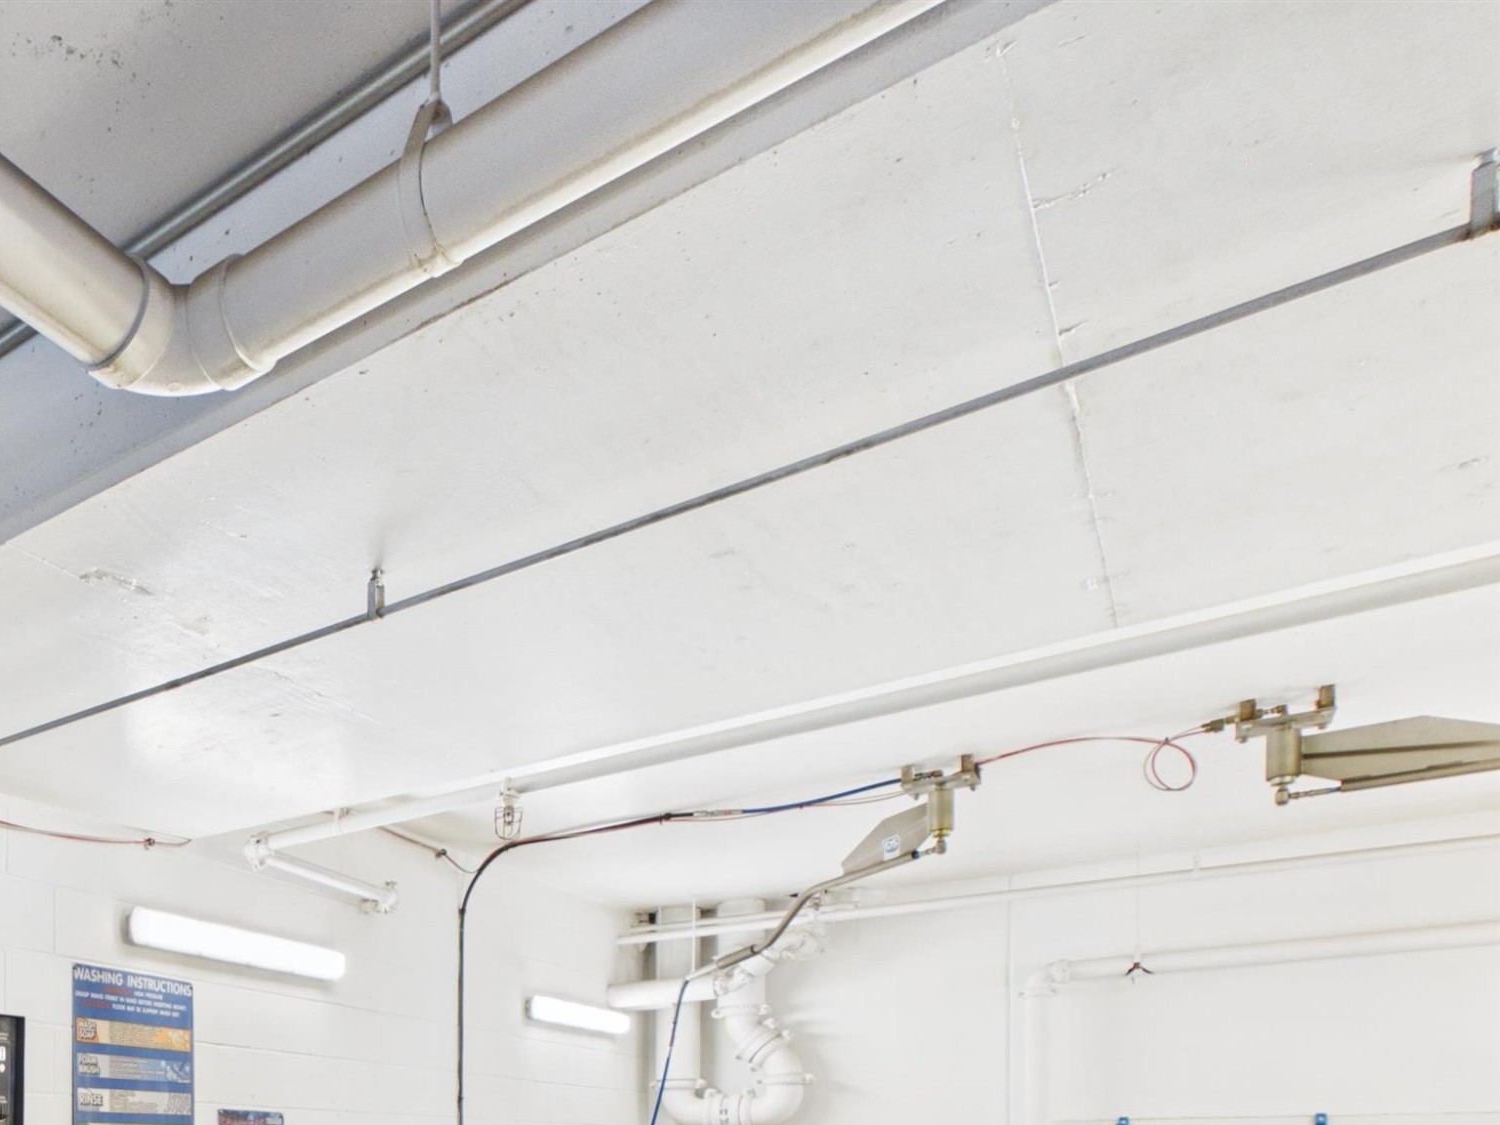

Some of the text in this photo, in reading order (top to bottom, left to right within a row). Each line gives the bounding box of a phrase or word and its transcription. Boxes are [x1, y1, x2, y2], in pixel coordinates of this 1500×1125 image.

[73, 967, 124, 986] WASHING
[127, 975, 192, 997] INSTRUCTIONS
[79, 1093, 103, 1106] RINSE
